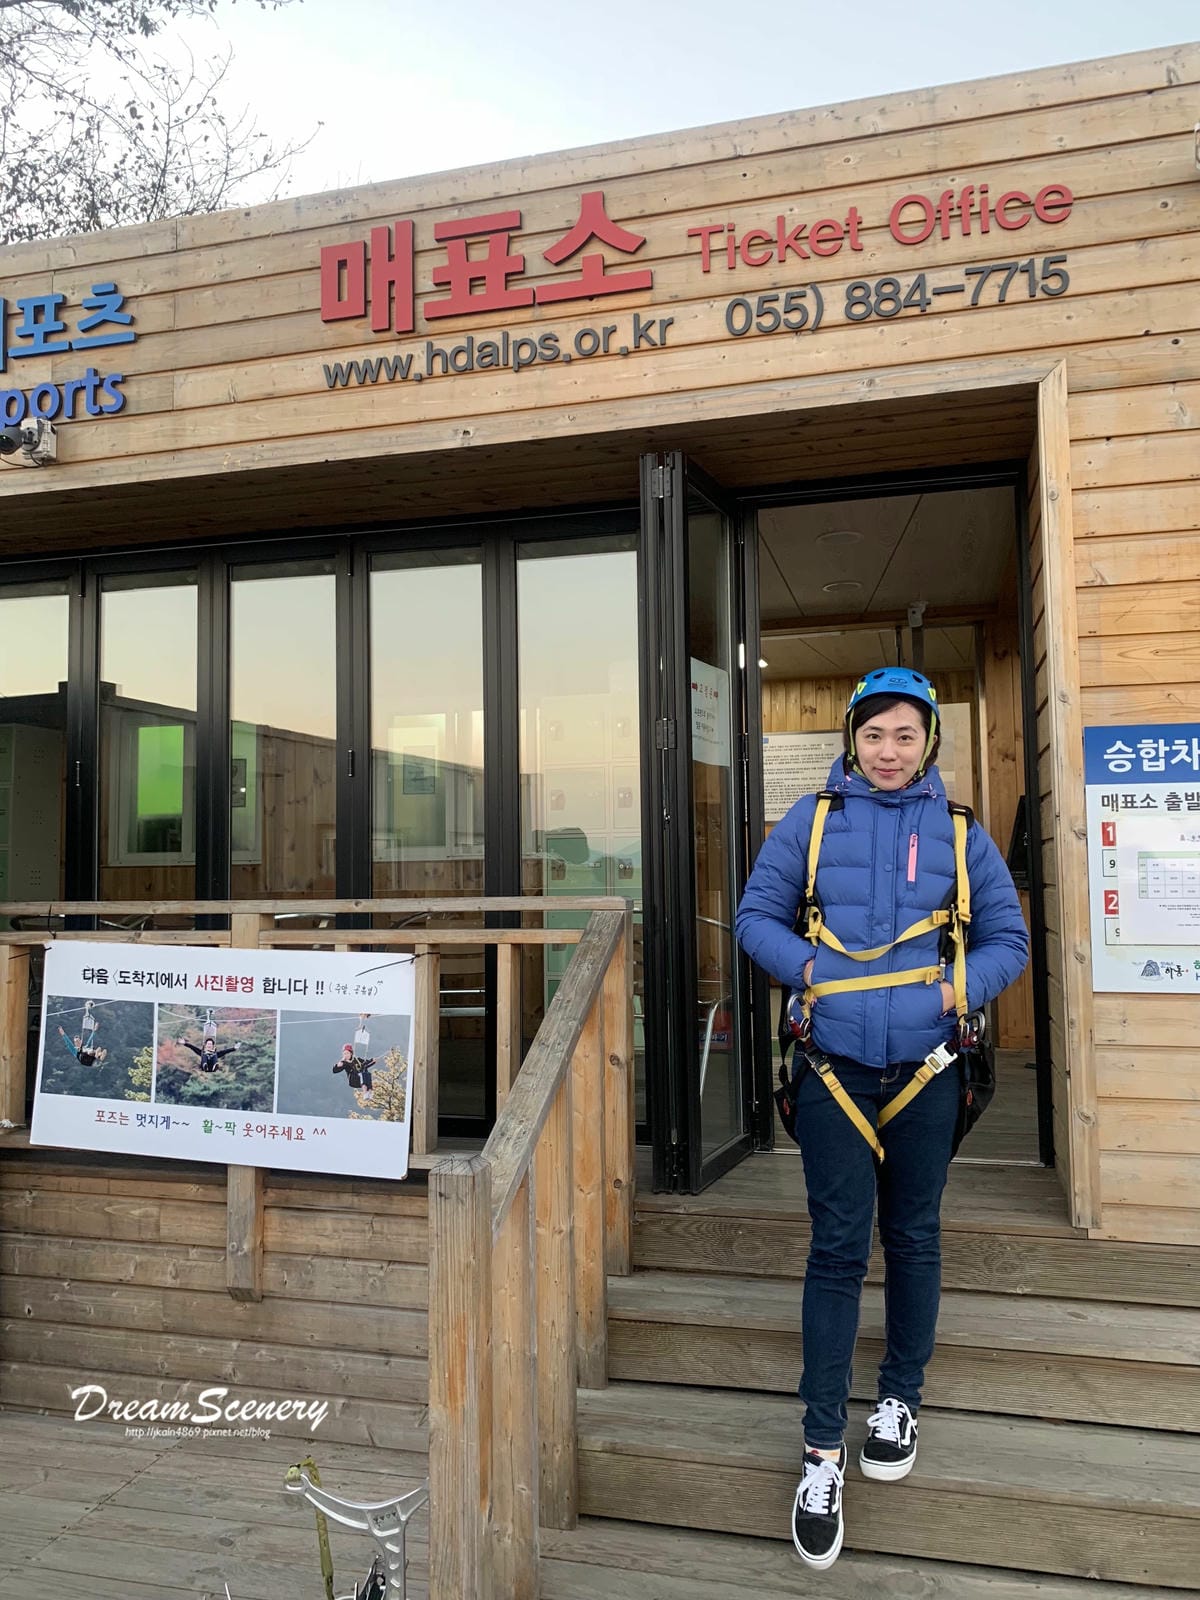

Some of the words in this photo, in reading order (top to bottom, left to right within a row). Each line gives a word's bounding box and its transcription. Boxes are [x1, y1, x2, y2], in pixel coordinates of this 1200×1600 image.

[688, 207, 863, 273] Ticket
[889, 184, 1074, 246] Office
[321, 191, 652, 334] 매표소
[726, 283, 823, 337] 055)
[844, 254, 1070, 321] 884-7715
[0, 283, 137, 373] 포츠
[323, 313, 675, 389] www.hdalps.or.kr
[1103, 738, 1200, 773] 승합차
[1101, 792, 1158, 812] 매표소
[1106, 825, 1114, 841] 1
[1107, 894, 1118, 910] 2
[82, 967, 109, 985] 다음
[194, 974, 254, 994] 사진촬영
[262, 977, 308, 996] 합니다
[315, 980, 324, 995] !!
[94, 1110, 130, 1126] 포즈는
[135, 1113, 191, 1131] 멋지게~~
[242, 1123, 306, 1141] 웃어주세요
